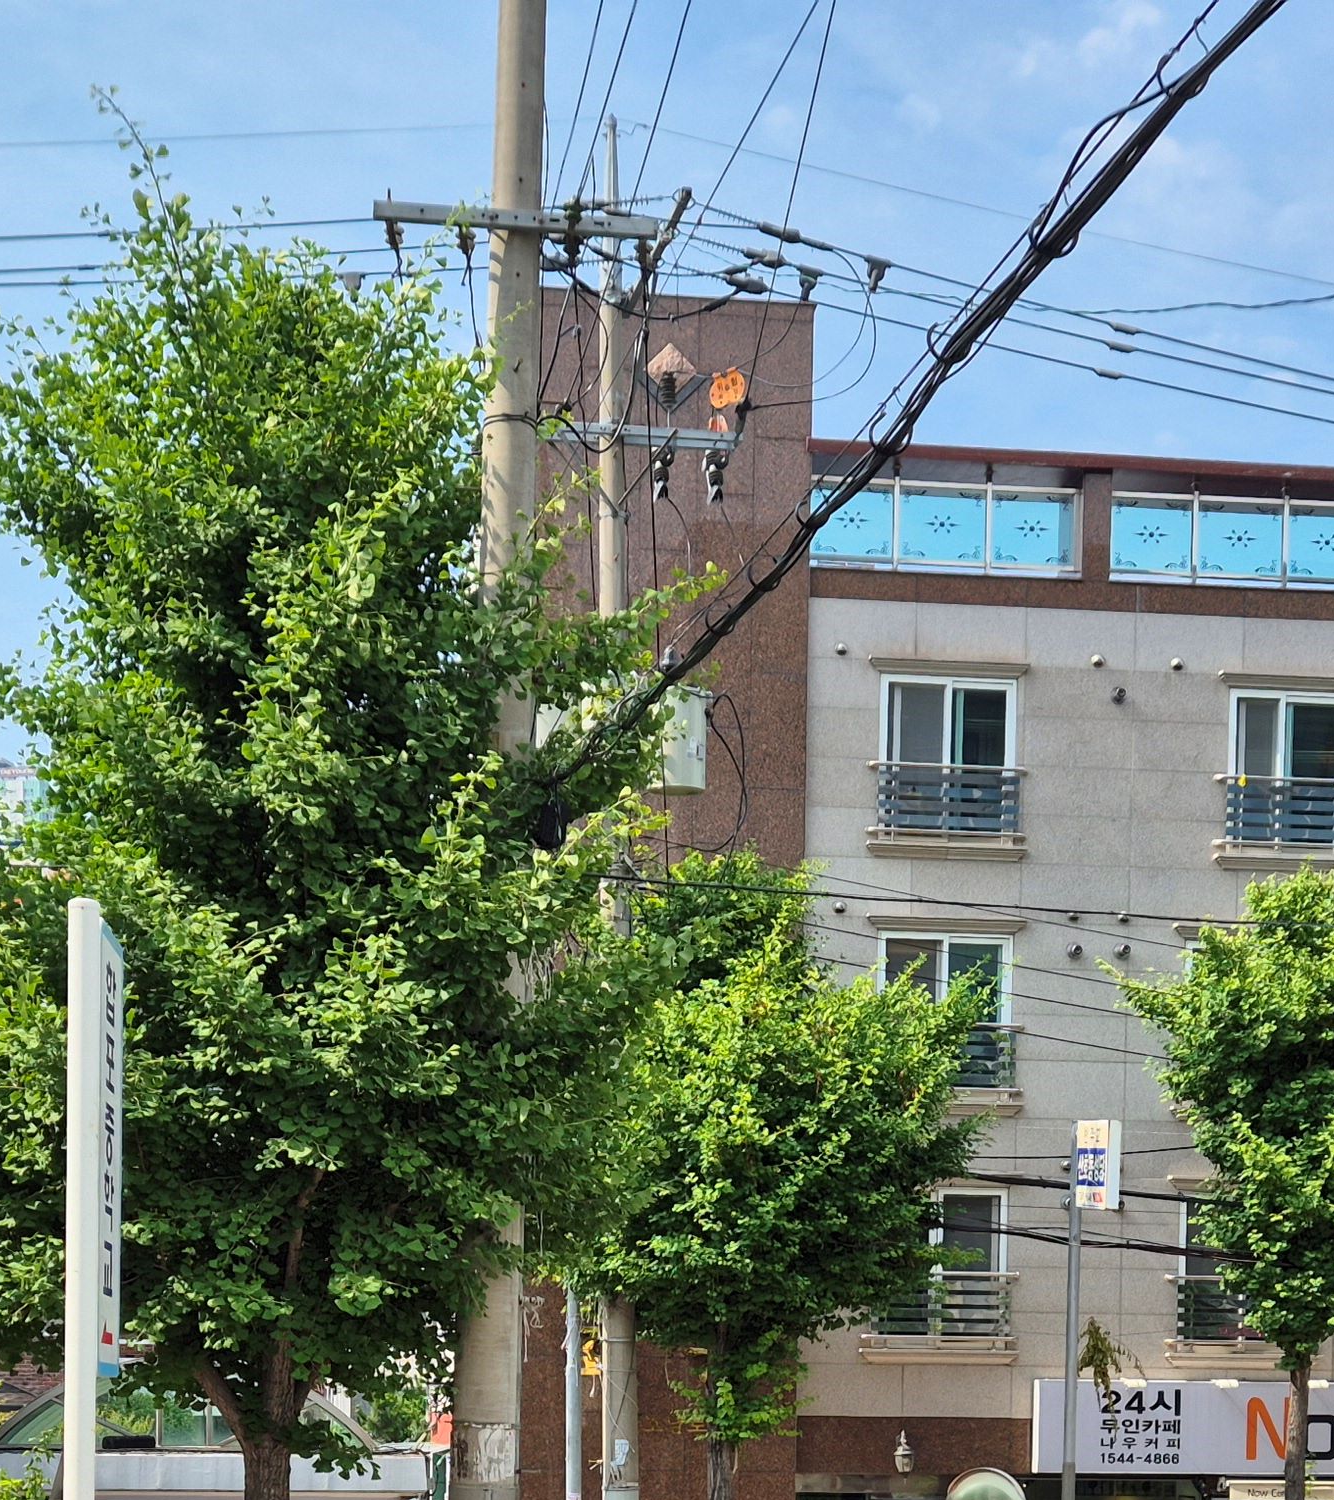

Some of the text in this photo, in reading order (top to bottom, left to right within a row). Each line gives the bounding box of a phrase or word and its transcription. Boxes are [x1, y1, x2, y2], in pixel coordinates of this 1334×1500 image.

[1100, 1389, 1181, 1416] 24시
[1100, 1419, 1181, 1435] 무인카페
[1100, 1453, 1180, 1465] 1544-4866
